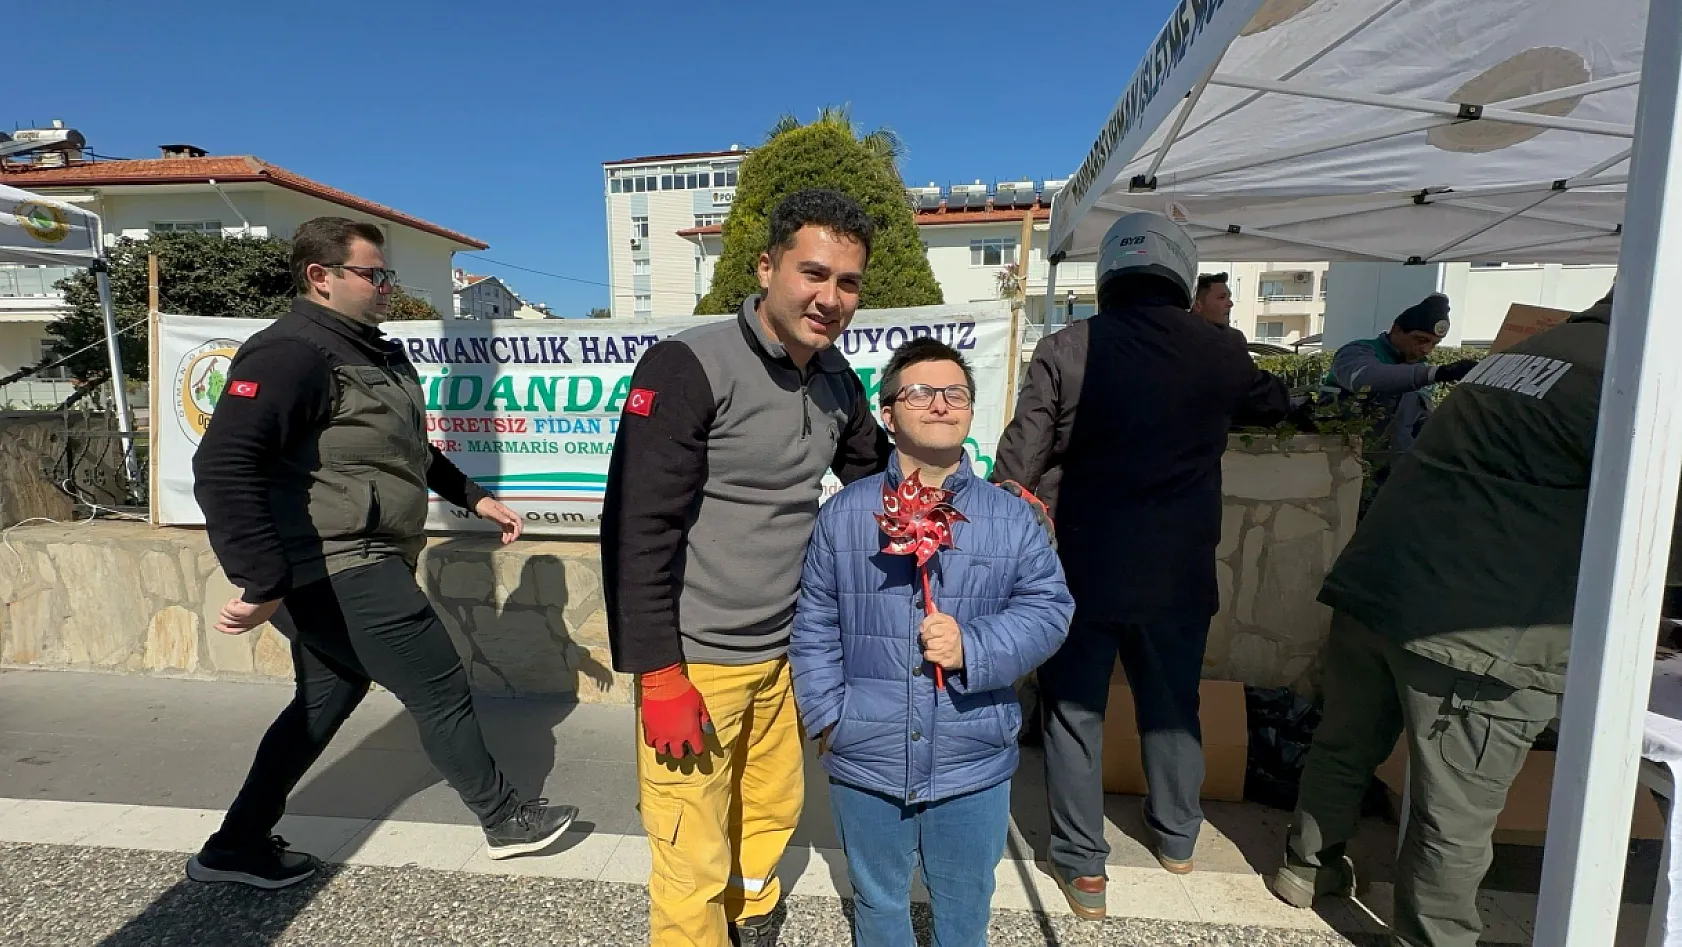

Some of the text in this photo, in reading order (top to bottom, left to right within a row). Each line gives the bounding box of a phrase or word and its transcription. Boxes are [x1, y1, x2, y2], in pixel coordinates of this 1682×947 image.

[391, 322, 977, 364] RMANCILIK HAFT UYORUZ
[420, 367, 631, 412] İDANDA
[425, 414, 527, 433] ÜCRETSİZ
[534, 415, 600, 434] FİDAN
[433, 440, 462, 452] ER:
[467, 438, 559, 454] MARMARİS
